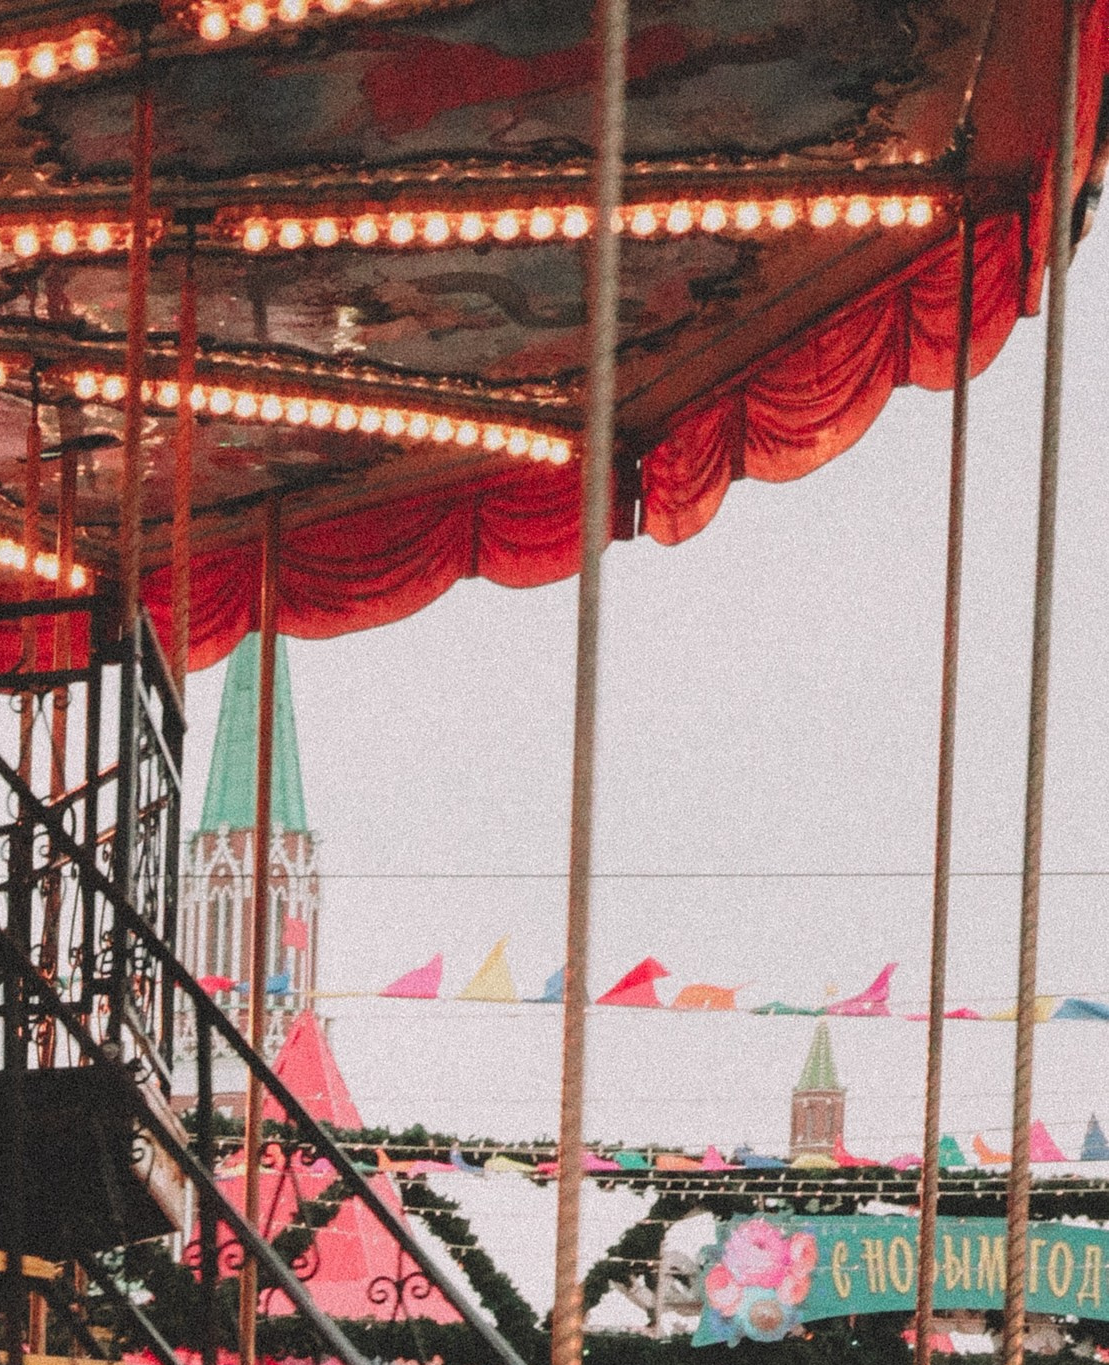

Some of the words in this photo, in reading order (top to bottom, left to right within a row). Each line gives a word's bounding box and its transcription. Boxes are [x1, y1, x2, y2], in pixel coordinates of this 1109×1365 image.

[831, 1240, 852, 1299] С
[860, 1234, 1008, 1297] НОЫМ
[1029, 1237, 1103, 1308] ГОД
